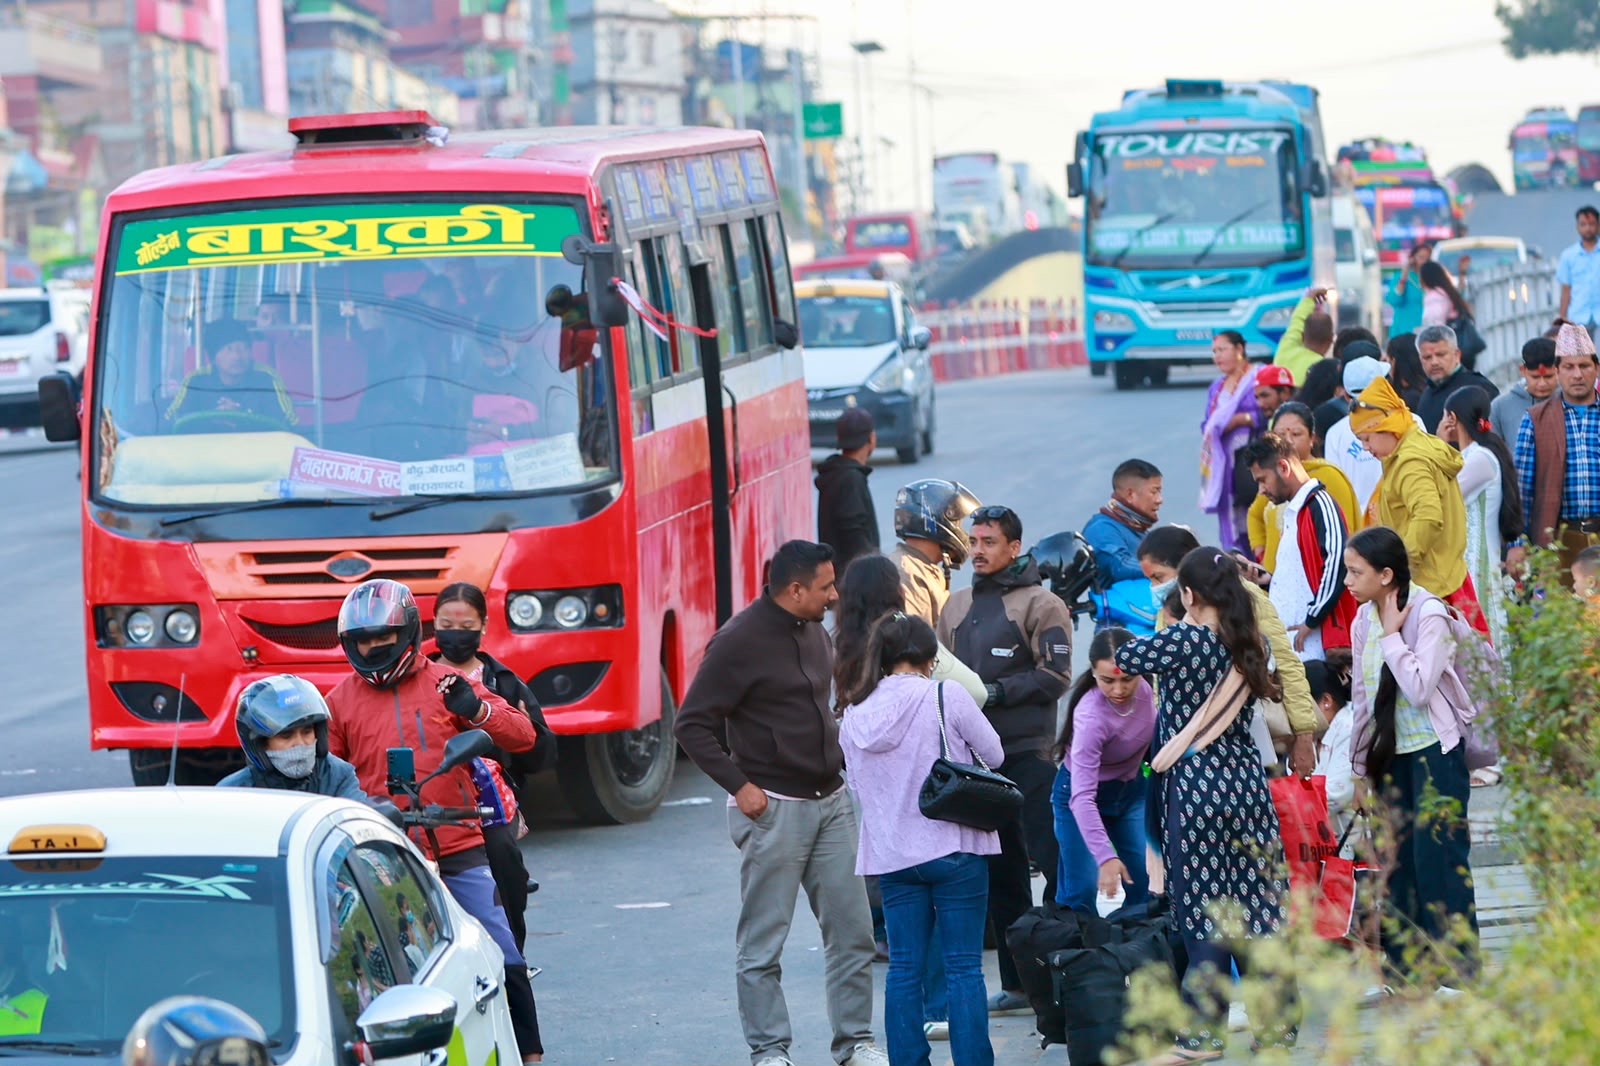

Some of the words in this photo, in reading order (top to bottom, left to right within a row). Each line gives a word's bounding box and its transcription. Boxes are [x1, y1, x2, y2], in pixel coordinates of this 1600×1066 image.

[1096, 131, 1290, 158] TOURIST
[187, 205, 535, 255] बाशुकी
[31, 836, 77, 849] TAI
